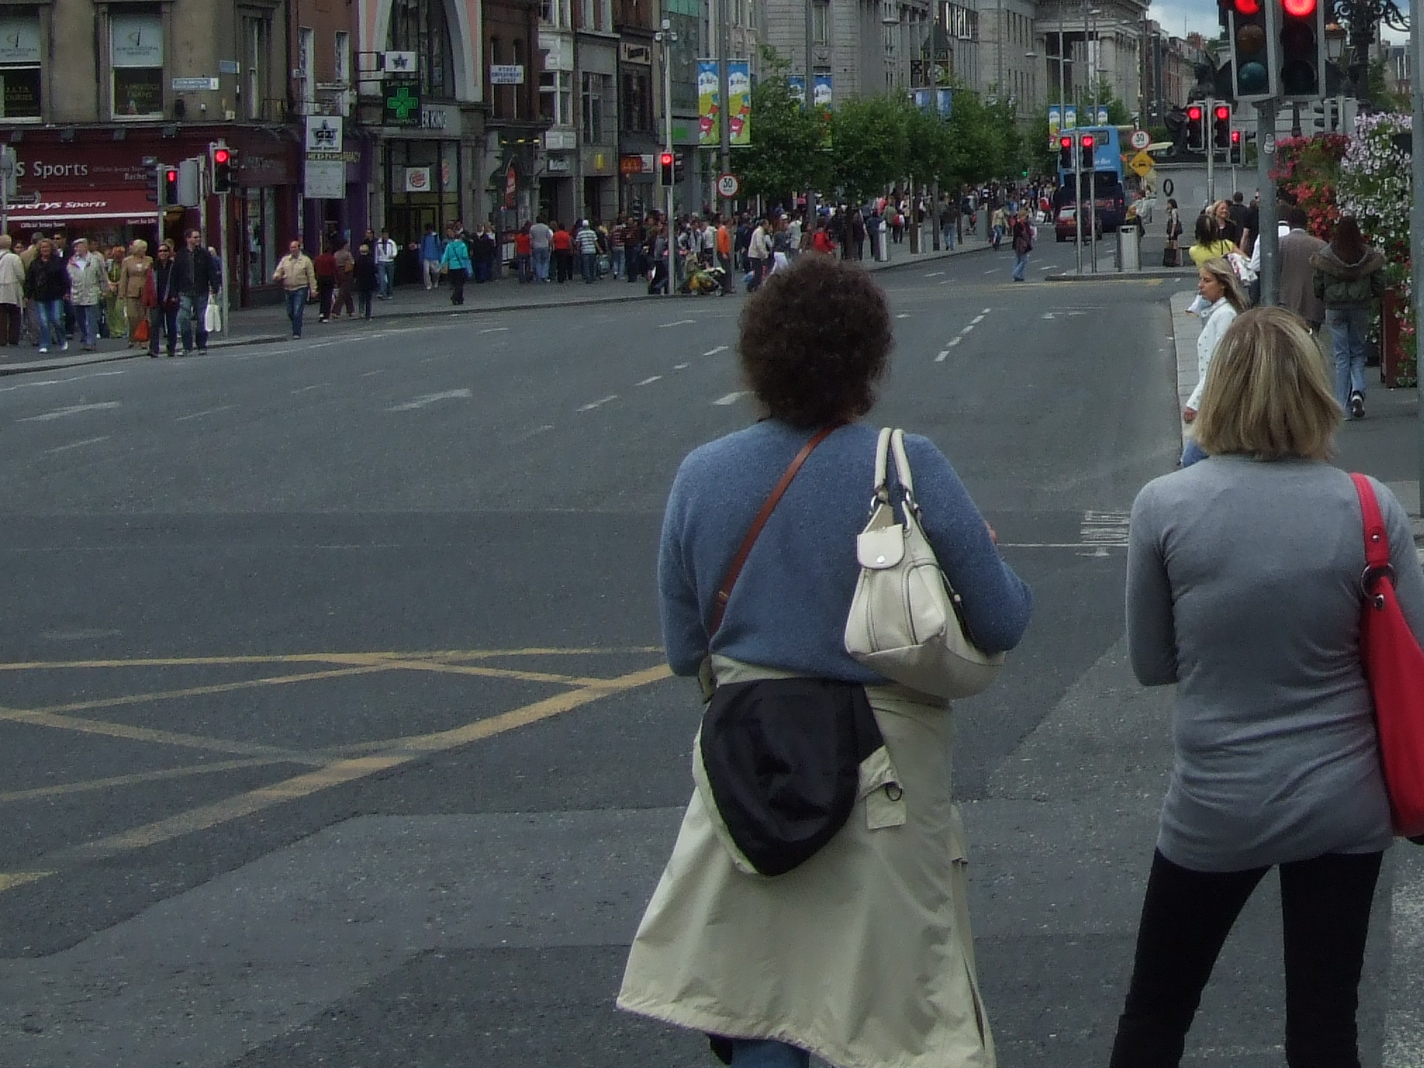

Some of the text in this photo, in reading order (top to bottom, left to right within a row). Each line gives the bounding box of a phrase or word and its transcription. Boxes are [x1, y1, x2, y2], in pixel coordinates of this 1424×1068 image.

[1135, 133, 1145, 143] 30
[33, 161, 88, 179] Sports
[723, 178, 733, 188] 30
[64, 200, 108, 209] Sports
